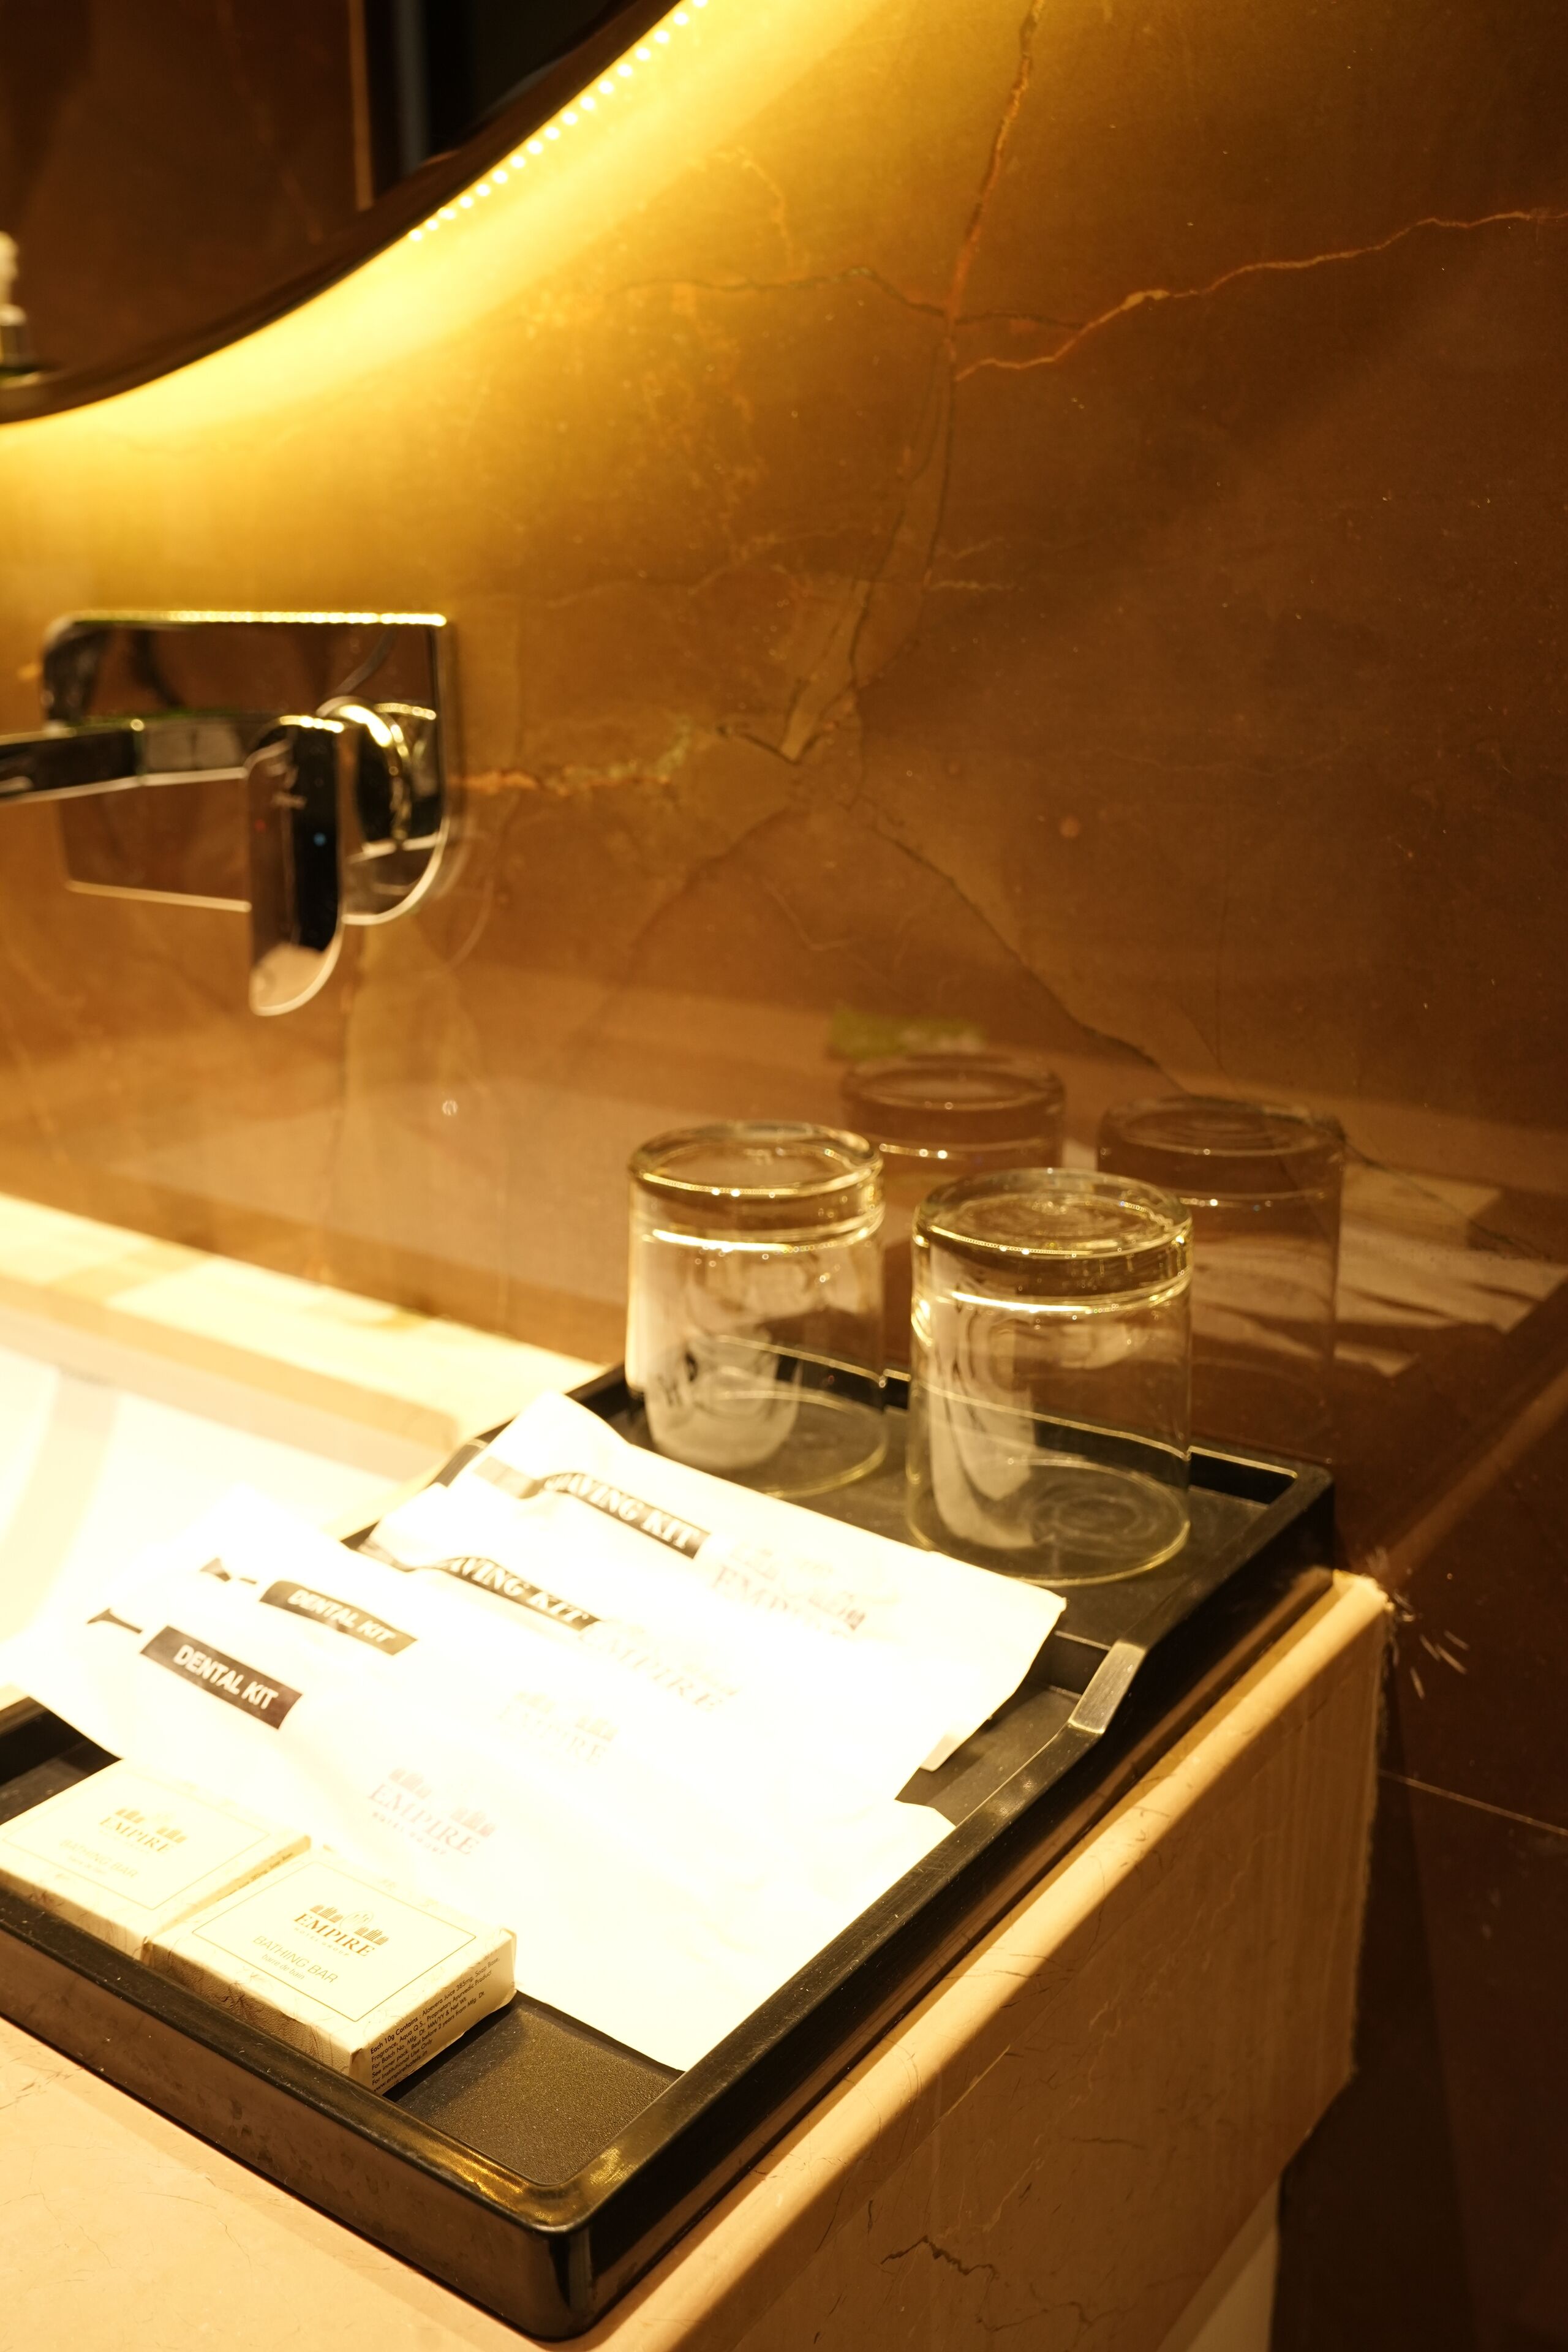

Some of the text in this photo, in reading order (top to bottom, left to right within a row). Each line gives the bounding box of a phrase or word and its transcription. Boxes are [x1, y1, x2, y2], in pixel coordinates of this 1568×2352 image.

[640, 1509, 700, 1550] KIT
[287, 1589, 396, 1643] DENTAL KIT
[526, 1591, 589, 1622] KIT
[173, 1644, 279, 1709] DENTAL KIT
[99, 1817, 174, 1855] EMPIRE
[368, 1784, 480, 1855] EMPIRE
[293, 1913, 375, 1956] EMPIRE
[252, 1936, 339, 1983] BATHING BAR
[370, 2042, 383, 2054] Each
[385, 2035, 395, 2044] 10g
[396, 2016, 418, 2035] Contains
[422, 1999, 443, 2016] Aloevera
[443, 1989, 456, 2001] Juice
[475, 1966, 487, 1977] Soap
[371, 2041, 398, 2062] Fragrance,
[399, 2030, 412, 2043] Aqua
[426, 2000, 452, 2022] Proprietary
[452, 1983, 474, 2002] Ayurvedic
[475, 1970, 492, 1986] Product
[372, 2069, 382, 2078] See
[382, 2059, 395, 2070] inner
[411, 2040, 421, 2050] Best
[422, 2027, 437, 2041] before
[443, 2015, 454, 2027] years
[456, 2006, 466, 2016] from
[372, 2062, 380, 2070] For
[382, 2051, 396, 2064] Batch
[382, 2055, 410, 2079] Institutional
[410, 2048, 420, 2058] Use
[421, 2038, 432, 2050] Only
